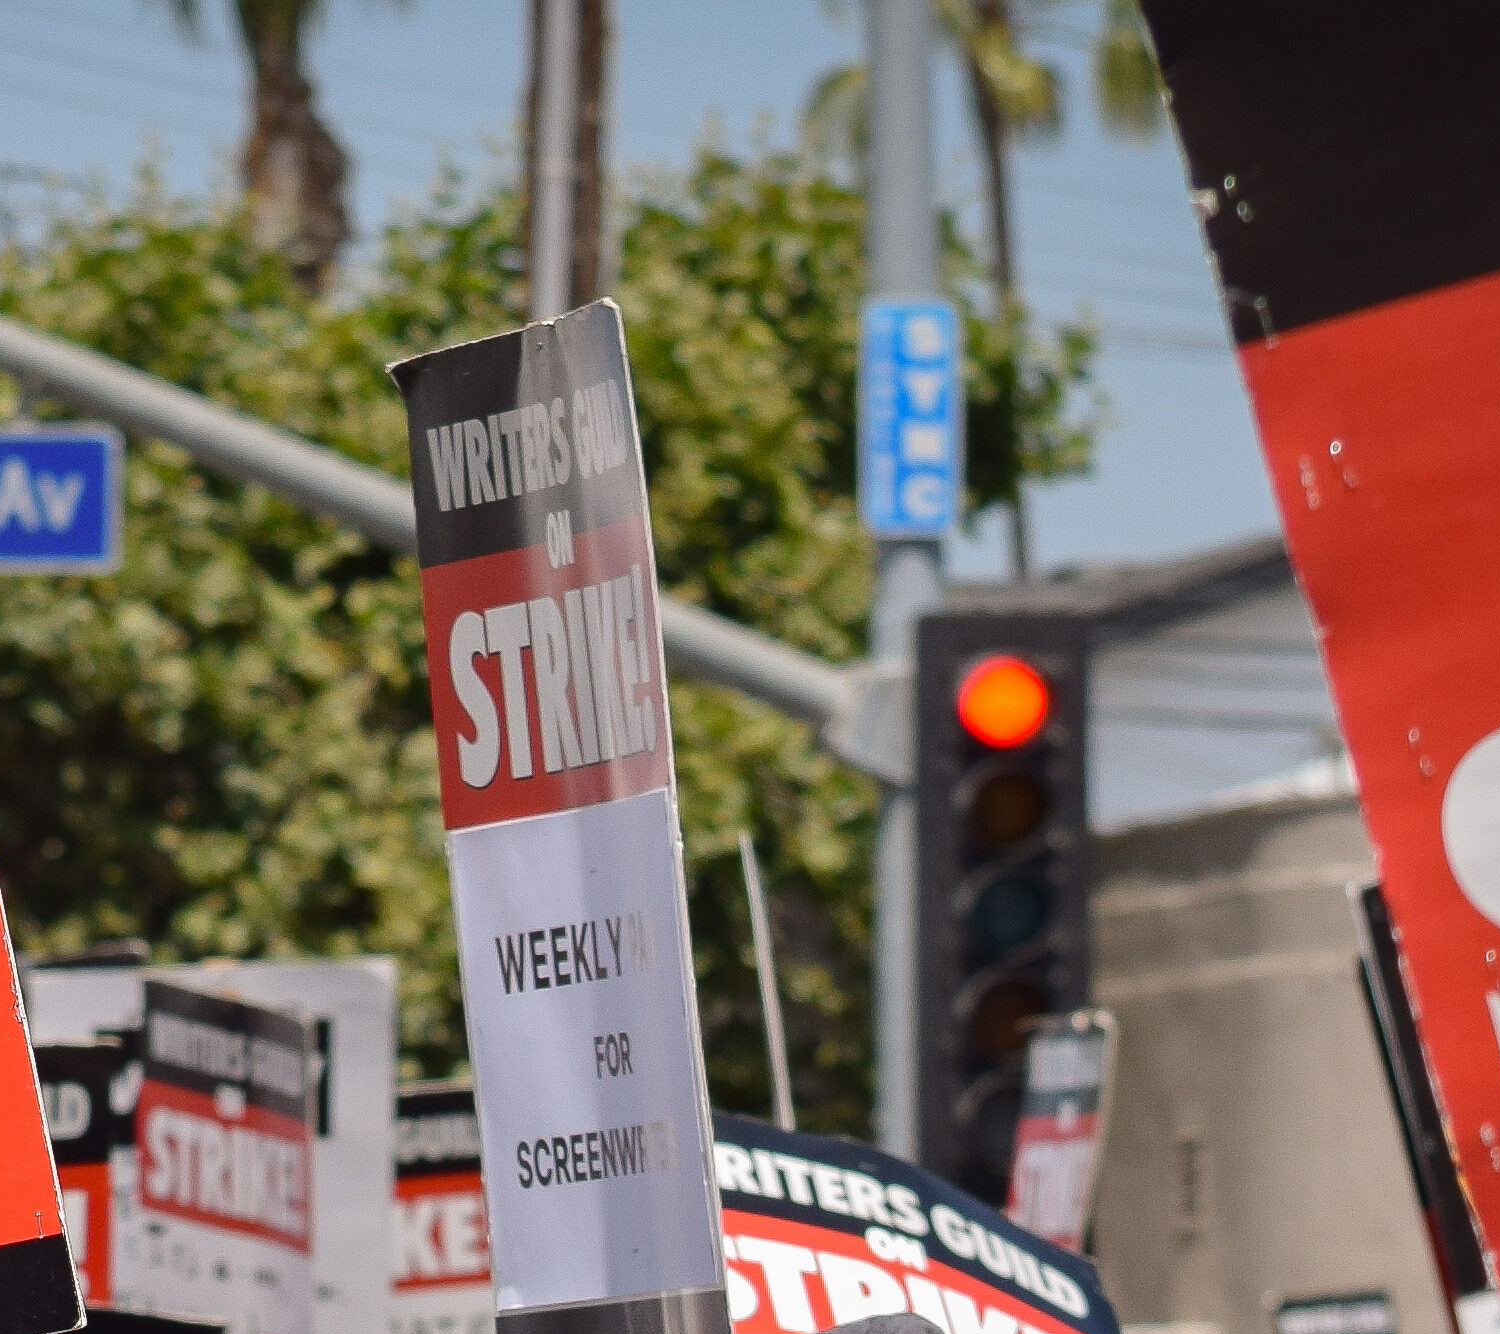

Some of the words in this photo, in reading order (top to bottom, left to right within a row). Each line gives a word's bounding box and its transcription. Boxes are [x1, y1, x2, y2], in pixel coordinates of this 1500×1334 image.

[426, 396, 571, 513] WRITERS
[545, 509, 575, 569] ON
[449, 563, 657, 789] STRIKE!
[495, 915, 625, 996] WEEKLY
[593, 1031, 633, 1079] FOR
[713, 1141, 931, 1237] RITERS
[930, 1203, 1091, 1319] GUILD
[863, 1225, 929, 1273] ON
